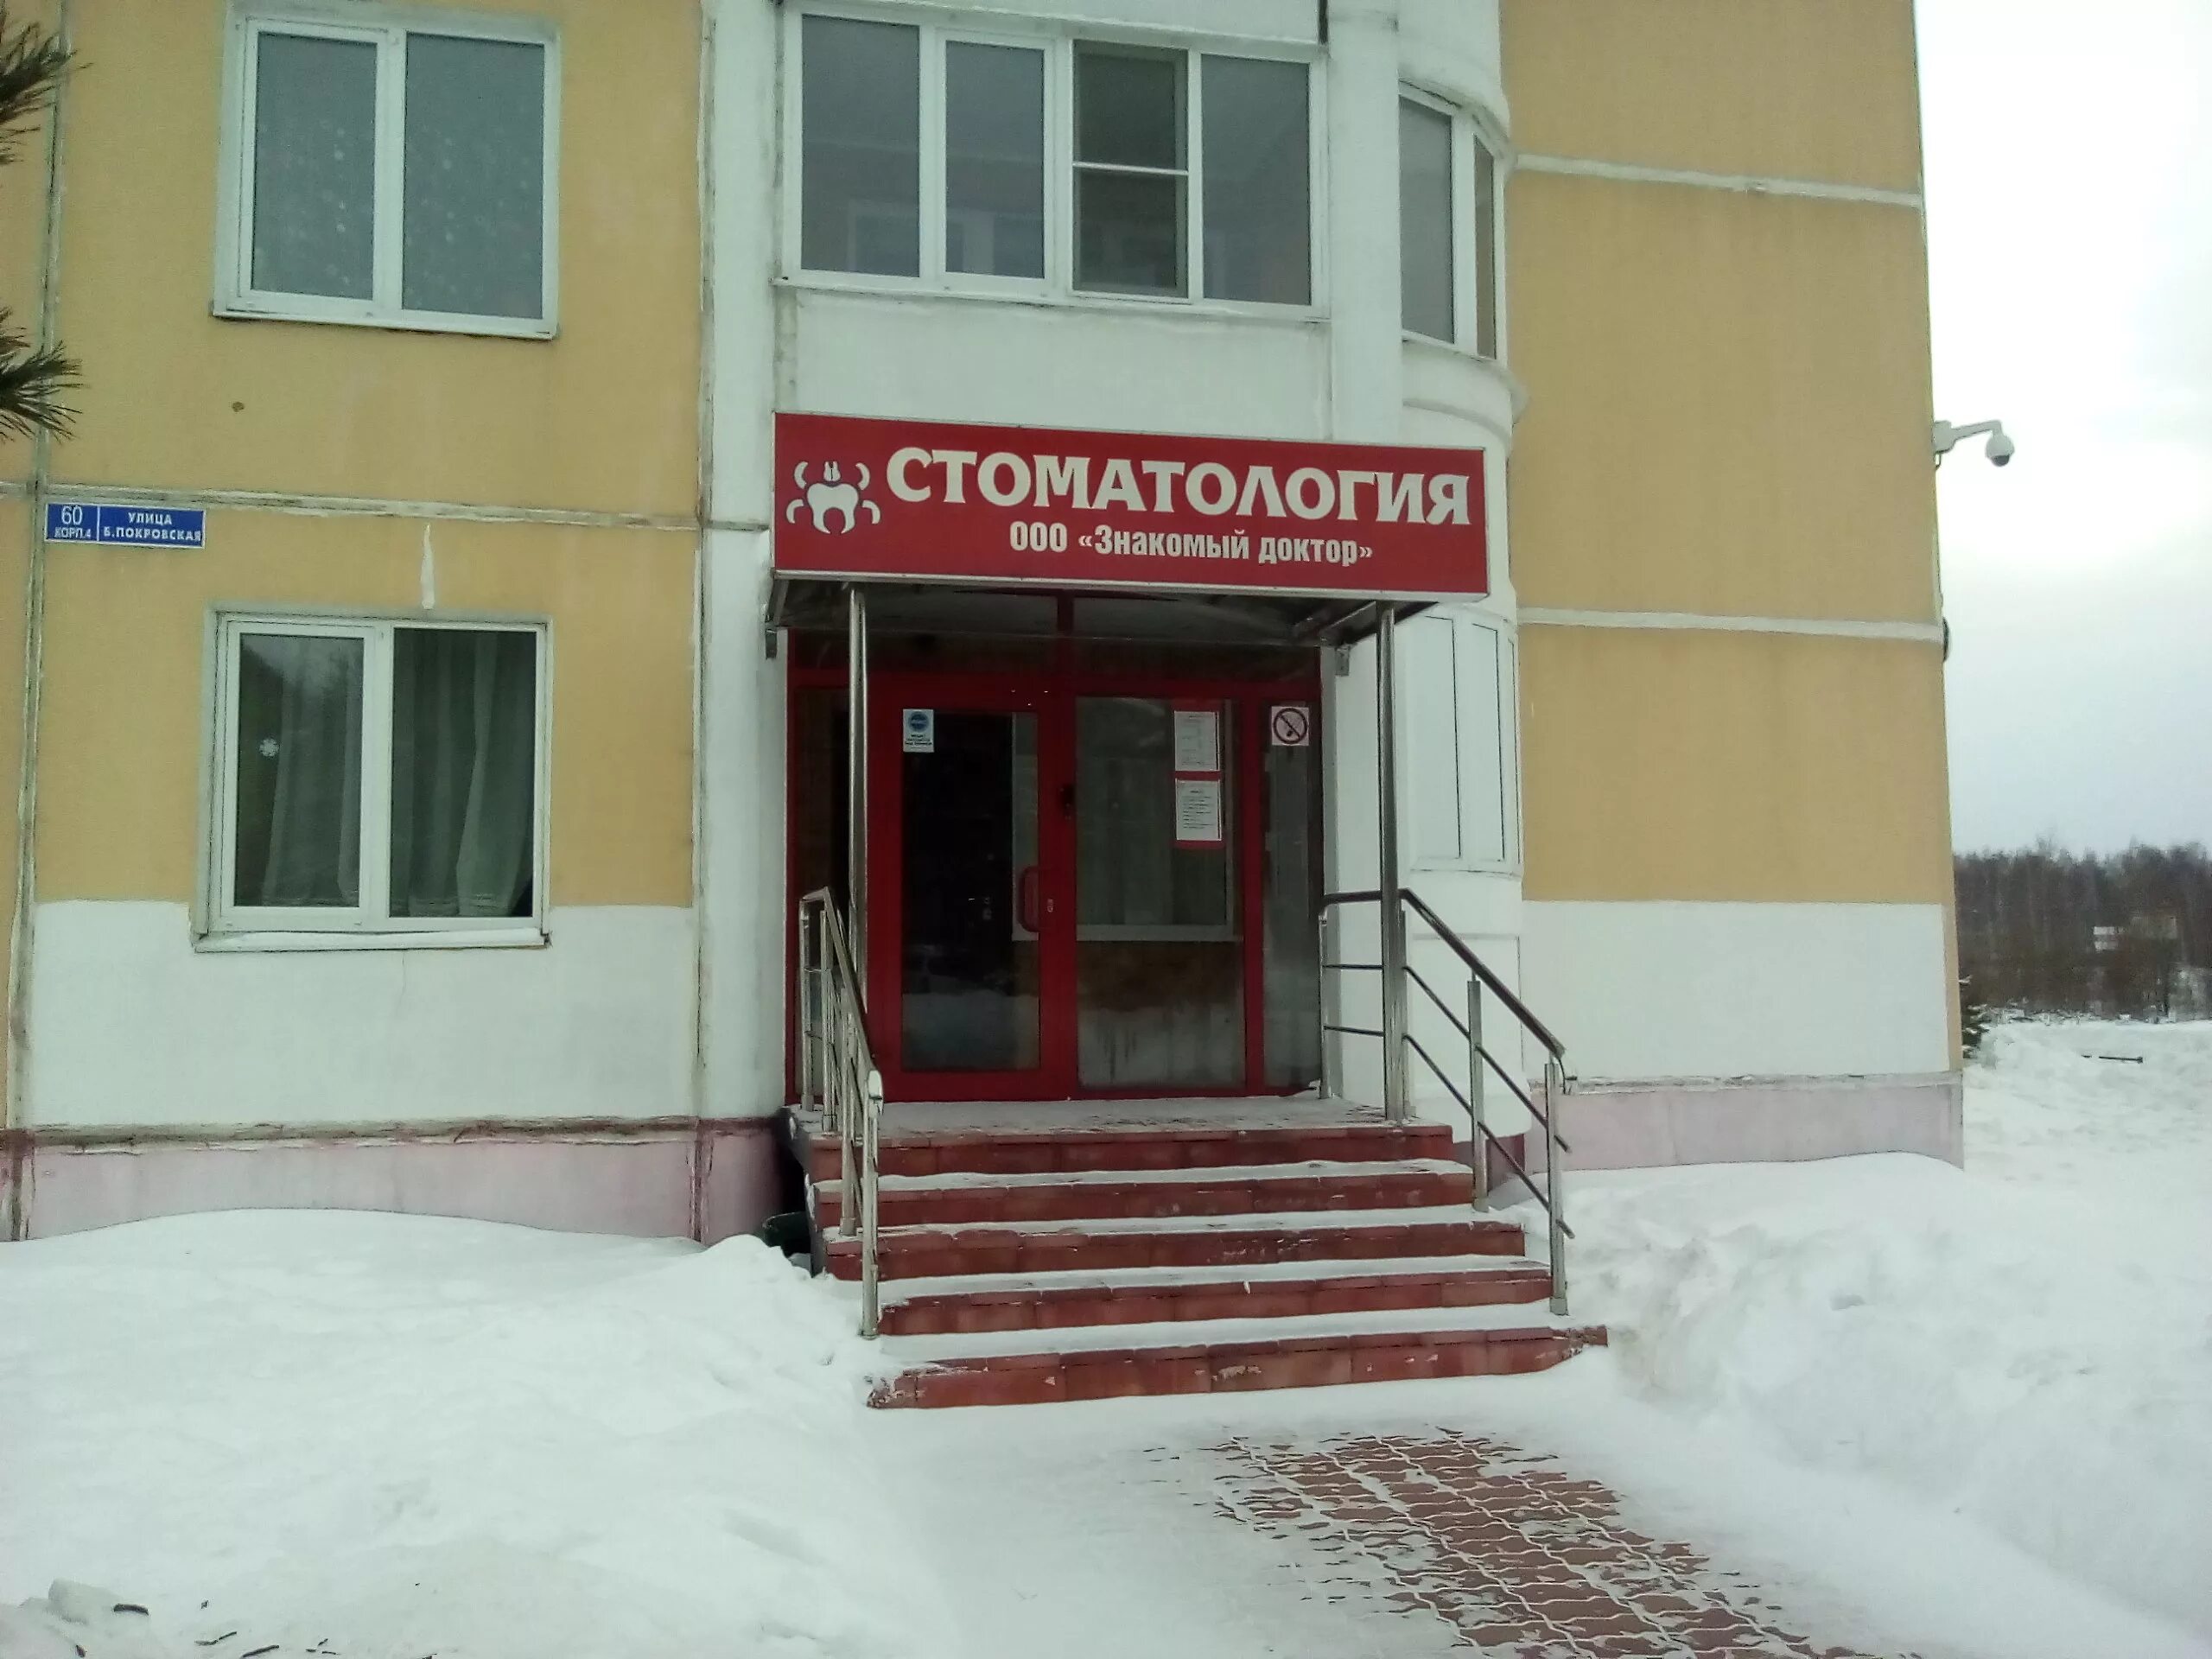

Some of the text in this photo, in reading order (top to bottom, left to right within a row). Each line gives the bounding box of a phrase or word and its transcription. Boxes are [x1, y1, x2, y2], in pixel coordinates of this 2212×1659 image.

[887, 447, 1471, 525] СТОМАТОЛОГИЯ
[61, 505, 83, 525] 60
[128, 512, 173, 525] УЛИЦА
[103, 526, 201, 542] Б.ПОКРОВСКАЯ
[1009, 520, 1373, 567] ООО «Знакомый доктор»
